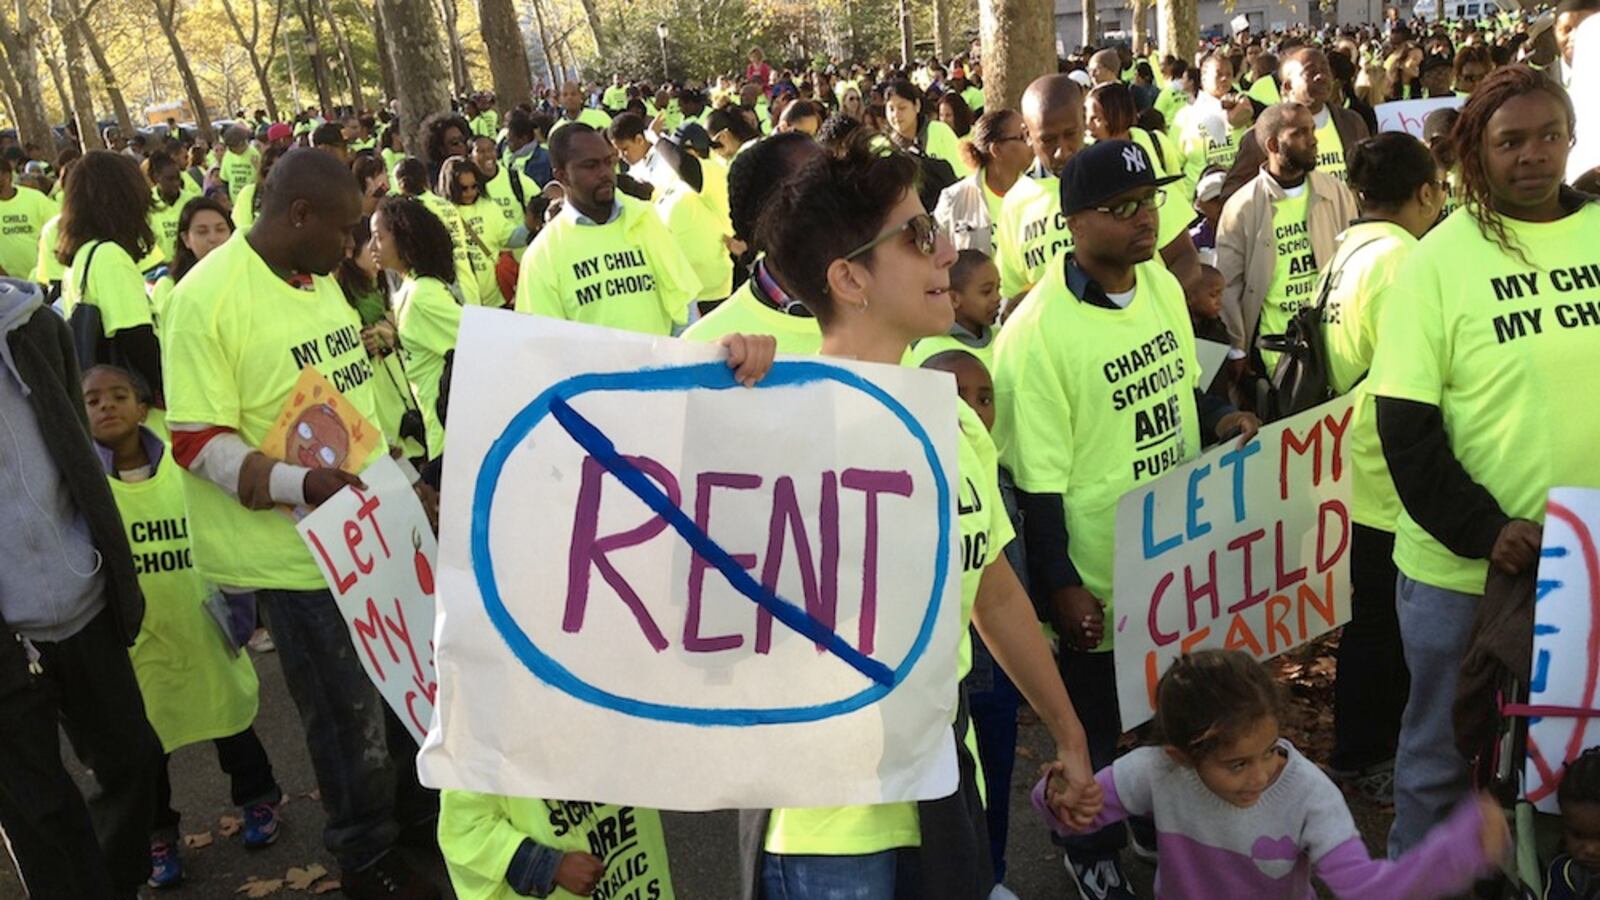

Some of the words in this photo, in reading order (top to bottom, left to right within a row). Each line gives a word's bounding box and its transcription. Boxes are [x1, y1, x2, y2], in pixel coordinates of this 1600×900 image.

[1121, 145, 1147, 172] NY
[572, 257, 600, 280] MY
[1490, 271, 1540, 302] MY
[575, 282, 602, 307] MY
[291, 339, 323, 370] MY
[325, 324, 360, 358] CHIL
[1492, 307, 1543, 344] MY
[1554, 301, 1600, 329] CH
[1103, 329, 1179, 384] CHARER
[1112, 357, 1185, 412] SCHOOLS
[1135, 394, 1181, 443] ARE
[1142, 440, 1261, 561] LET
[1279, 405, 1354, 501] MY
[561, 454, 914, 656] RENT
[1147, 499, 1350, 647] CHILD
[587, 805, 638, 862] ARE
